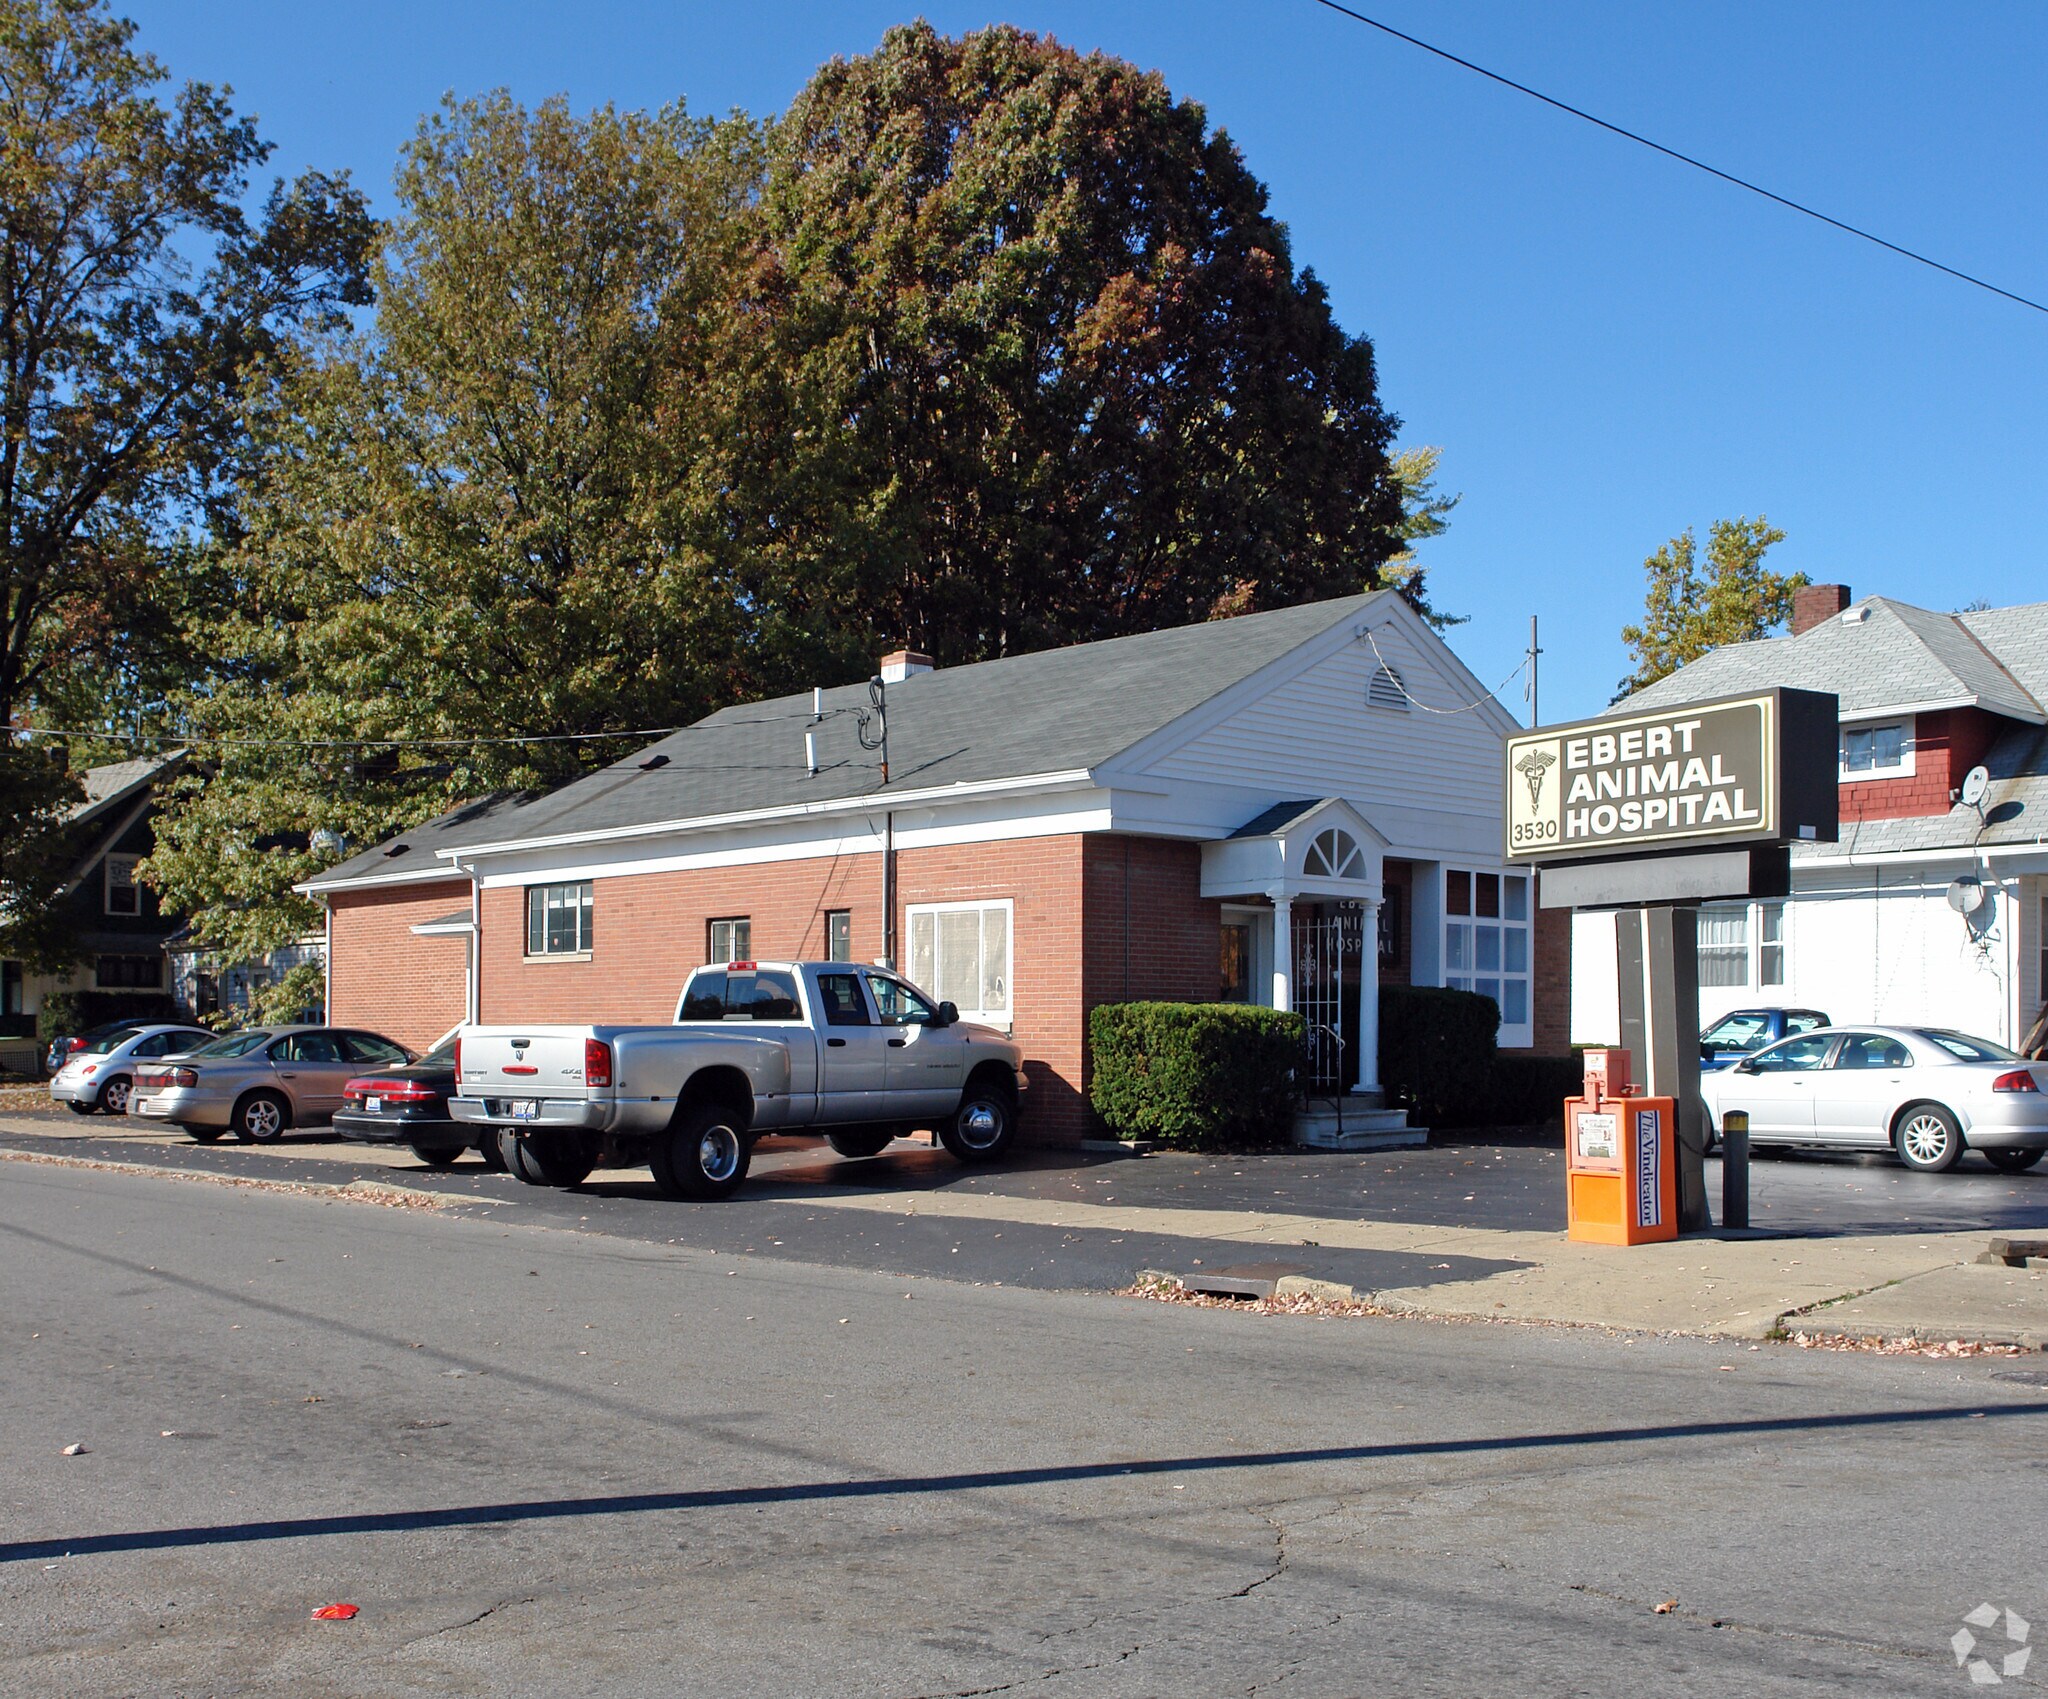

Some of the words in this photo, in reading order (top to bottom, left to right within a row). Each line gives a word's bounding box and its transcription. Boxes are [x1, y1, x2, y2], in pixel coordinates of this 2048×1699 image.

[1566, 720, 1701, 769] EBERT
[1566, 754, 1736, 805] ANIMAL
[1514, 819, 1558, 842] 3530
[1566, 788, 1759, 839] HOSPITAL
[1332, 916, 1388, 932] ANIL
[1328, 938, 1393, 953] HOSPAL
[1642, 1112, 1654, 1139] The
[1642, 1139, 1654, 1224] Vindicator
